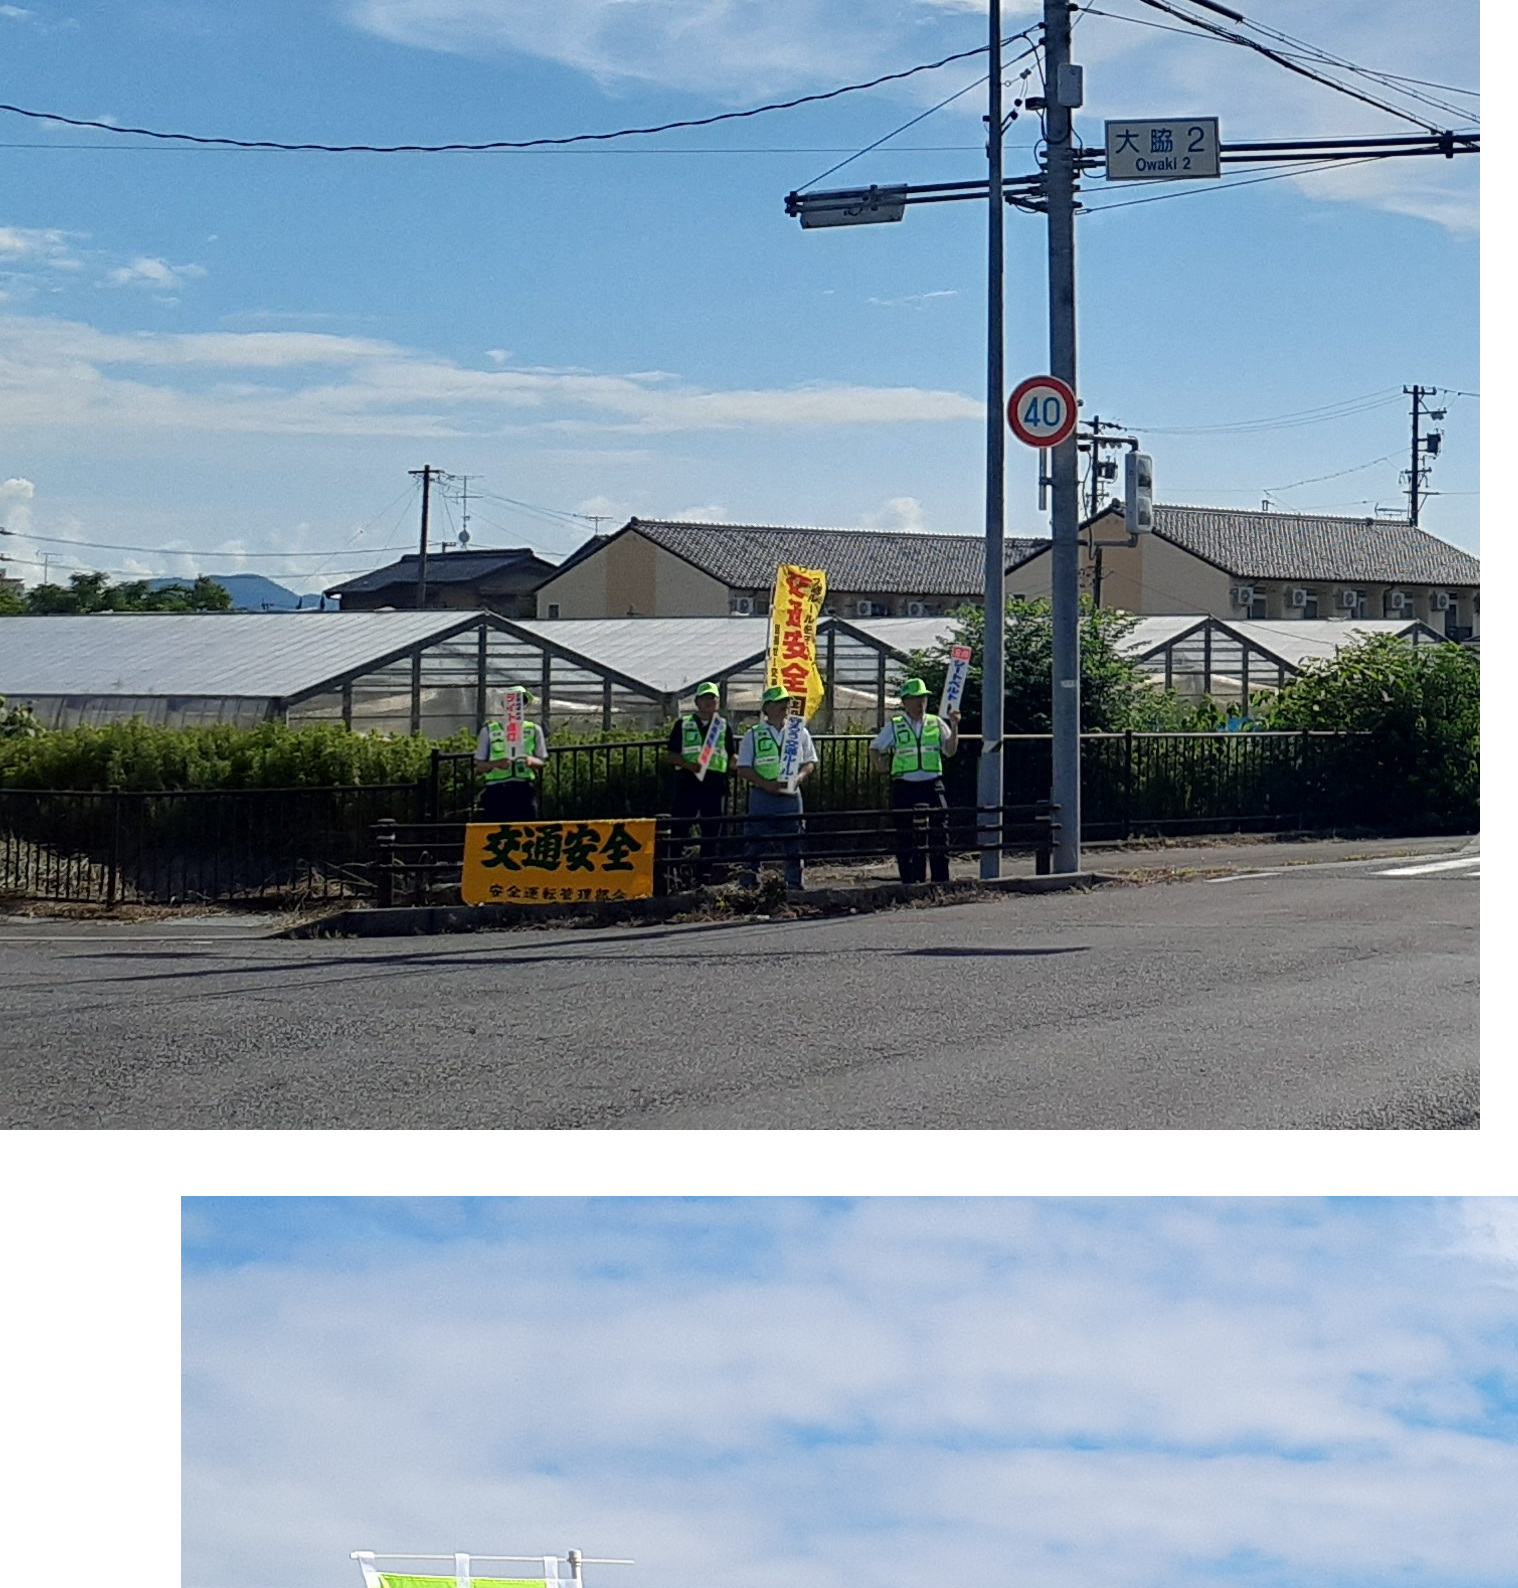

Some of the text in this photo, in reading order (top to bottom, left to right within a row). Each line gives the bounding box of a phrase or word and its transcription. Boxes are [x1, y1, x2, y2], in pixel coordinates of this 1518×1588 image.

[1135, 157, 1192, 172] Owaki 2
[1023, 396, 1061, 427] 40
[480, 823, 643, 872] 交通安全
